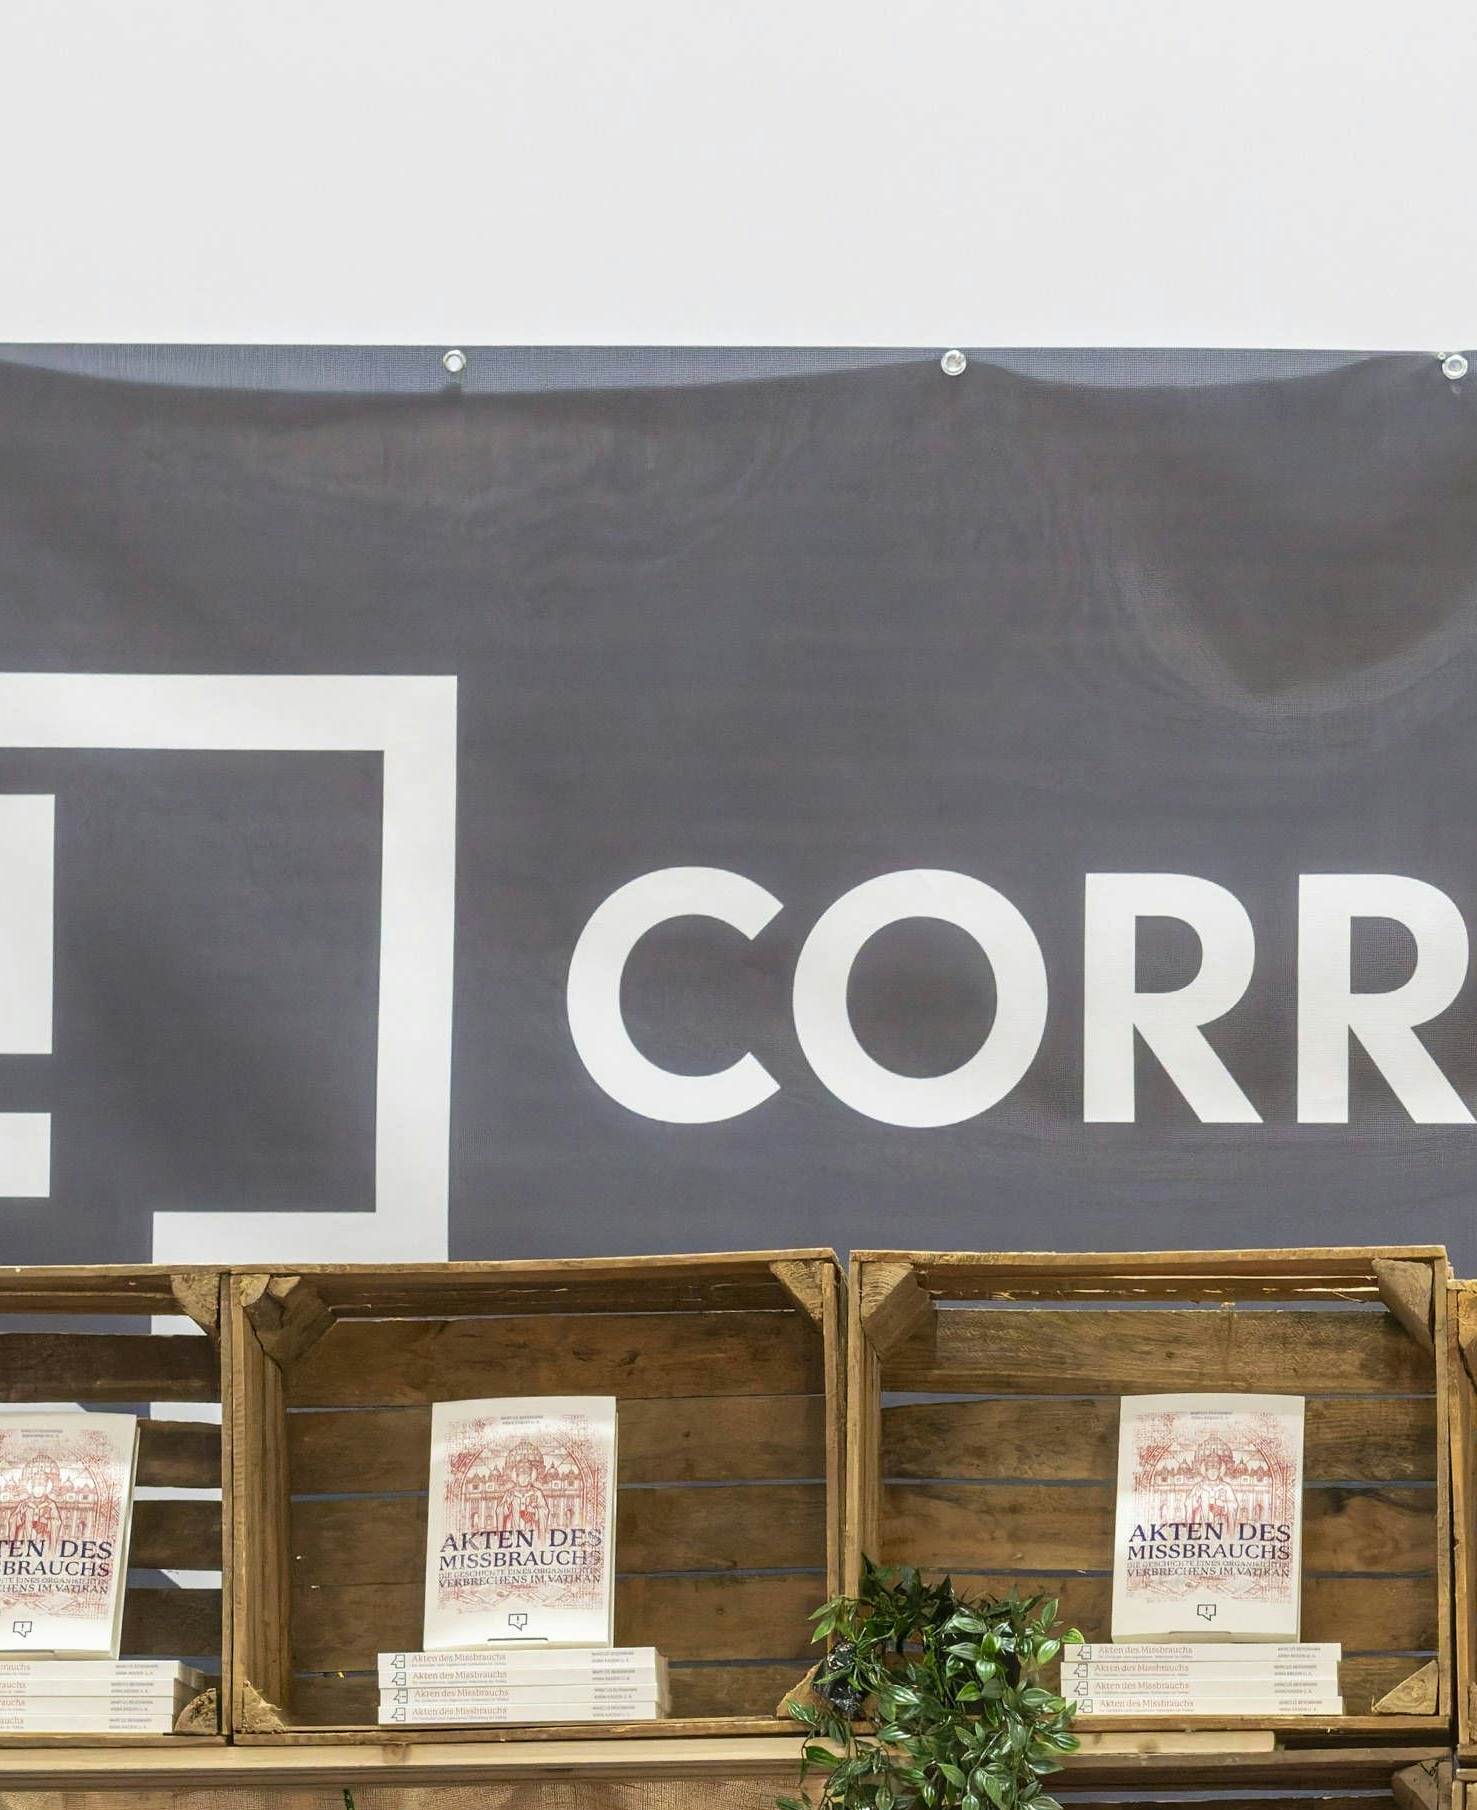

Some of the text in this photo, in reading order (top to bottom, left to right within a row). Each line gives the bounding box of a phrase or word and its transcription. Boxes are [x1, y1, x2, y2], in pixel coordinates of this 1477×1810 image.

[440, 1529, 602, 1553] AKTEN DES
[1128, 1522, 1291, 1542] AKTEN DES
[60, 1541, 112, 1560] DES
[439, 1550, 601, 1570] MISSBRAUCHS
[1128, 1544, 1290, 1560] MISSBRAUCHS
